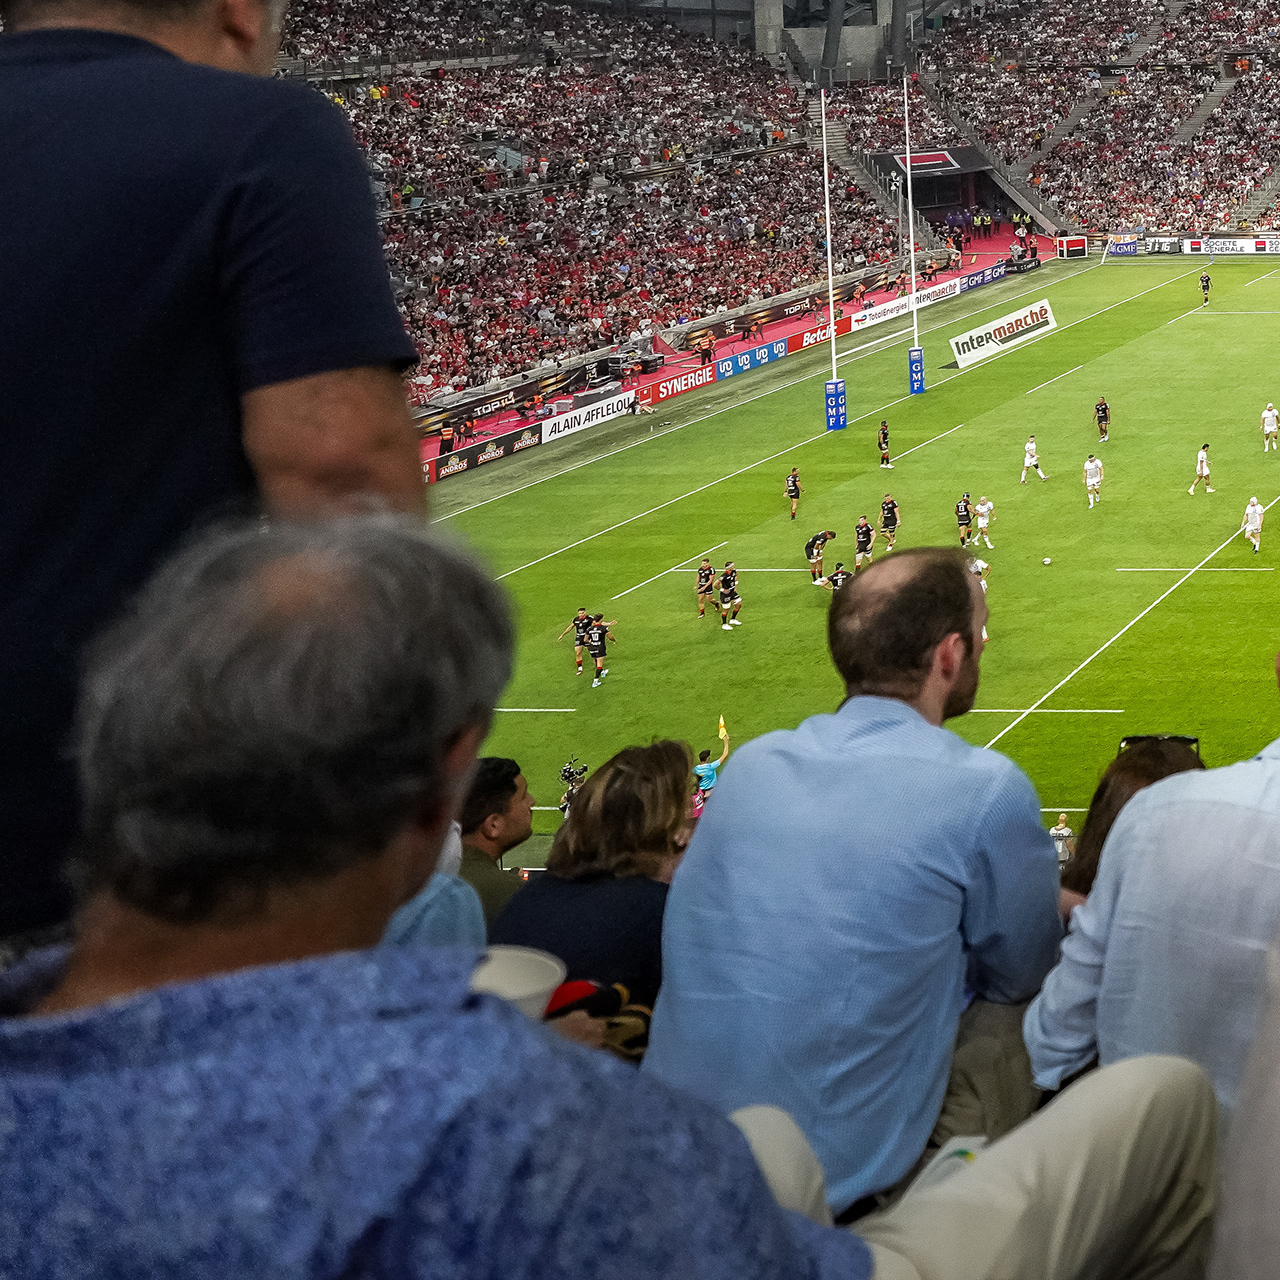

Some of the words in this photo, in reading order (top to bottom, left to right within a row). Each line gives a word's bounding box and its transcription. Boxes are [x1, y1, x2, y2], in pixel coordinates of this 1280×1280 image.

[1116, 244, 1136, 253] GMF
[968, 275, 984, 287] GMF
[914, 282, 958, 304] ntermarché
[868, 301, 908, 322] TotalEnergies
[954, 306, 1048, 356] Intermarché
[658, 366, 714, 398] SYNERGIE
[474, 392, 516, 416] TOP14
[549, 413, 581, 436] ALAIN
[584, 396, 630, 424] AFFLELOU
[514, 434, 539, 451] ANDROS
[478, 448, 504, 463] ANDROS
[439, 460, 467, 477] ANDROS
